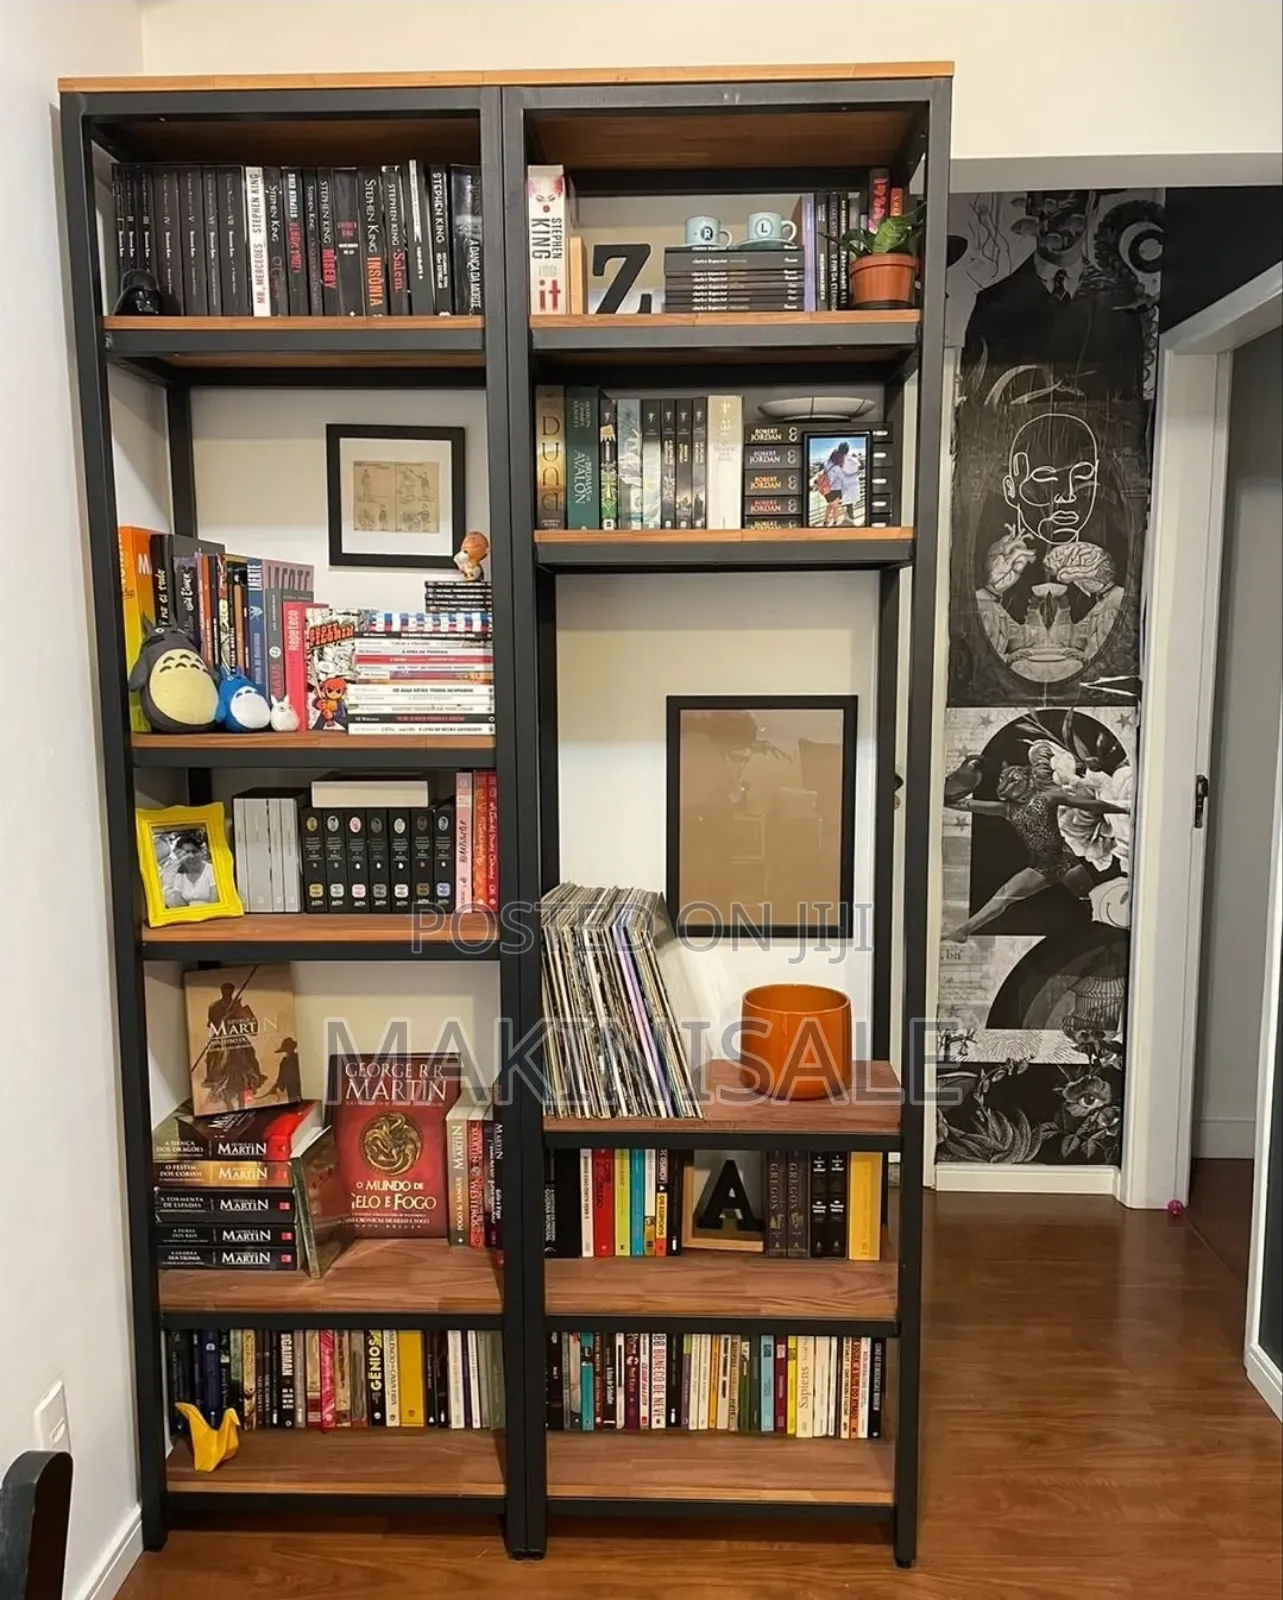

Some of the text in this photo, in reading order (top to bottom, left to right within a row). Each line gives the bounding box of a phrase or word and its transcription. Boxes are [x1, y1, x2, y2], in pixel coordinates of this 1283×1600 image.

[249, 174, 260, 194] KING
[288, 173, 298, 218] STEPHEN KING
[307, 185, 316, 211] STEPHEN
[433, 172, 443, 216] STEPHEN
[250, 196, 262, 233] STEPHEN
[266, 185, 281, 219] STEPHEN
[388, 184, 399, 222] STEPHEN
[270, 221, 279, 242] KING
[320, 181, 336, 288] STEPHEN KING MISERY
[364, 179, 385, 306] STEPHEN KING INSÔNIA
[391, 224, 400, 246] KING
[435, 218, 445, 243] KING
[531, 218, 551, 259] KING
[551, 218, 562, 259] STEPHEN
[253, 243, 266, 286] MERCEDES
[593, 244, 651, 314] Z
[539, 279, 561, 311] it
[750, 455, 780, 463] JORDAN
[573, 450, 583, 504] AVALON
[750, 481, 781, 490] JORDAN
[288, 610, 299, 651] Repeteco
[272, 663, 281, 698] MAUS
[210, 1017, 278, 1036] MARTIN
[345, 1063, 413, 1078] GEORGE
[346, 1079, 446, 1101] MARTIN
[217, 1142, 267, 1155] MARTIN
[452, 1125, 464, 1170] MARTIN
[471, 1127, 479, 1162] MARTIN
[495, 1123, 503, 1160] MARTIN
[219, 1167, 267, 1180] MARTIN
[365, 1181, 411, 1191] MUNDO
[414, 1182, 424, 1190] DE
[770, 1163, 779, 1210] GREGOS
[789, 1163, 798, 1210] GREGOS
[220, 1199, 269, 1211] MARTIN
[385, 1197, 391, 1208] E
[394, 1193, 437, 1210] FOGO
[470, 1180, 480, 1226] WESTEROS
[696, 1160, 762, 1231] A
[222, 1230, 271, 1242] MARTIN
[222, 1252, 270, 1264] MARTIN
[281, 1339, 293, 1376] GAIMAN
[653, 1349, 666, 1382] BONECO
[654, 1385, 665, 1394] DE
[799, 1366, 812, 1409] Sapiens
[653, 1397, 664, 1417] NEVE
